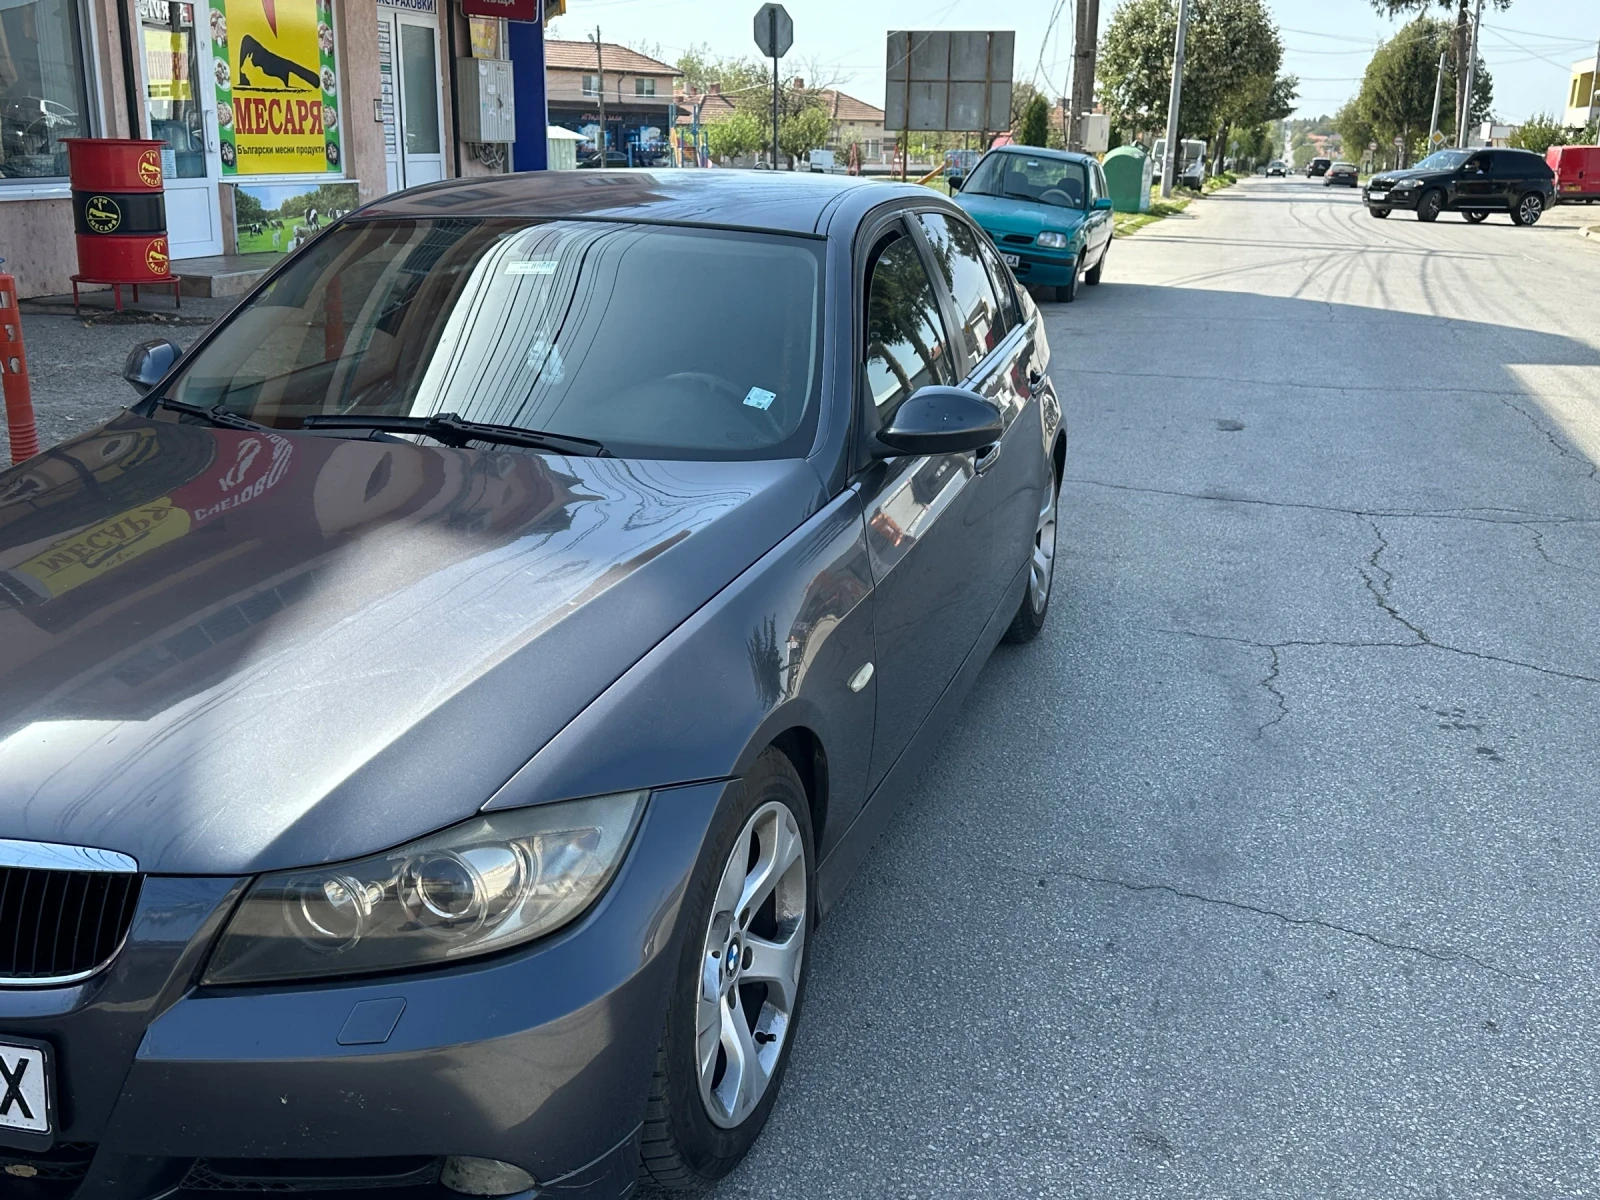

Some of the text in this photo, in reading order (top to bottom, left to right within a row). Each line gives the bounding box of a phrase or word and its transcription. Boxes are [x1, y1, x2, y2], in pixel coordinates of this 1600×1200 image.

[376, 0, 433, 11] РАХОВКИ
[233, 98, 324, 135] МЕСАРЯ
[237, 144, 325, 157] Български месни продукти
[90, 219, 117, 231] МЕСАРЯ
[0, 1055, 35, 1119] X
